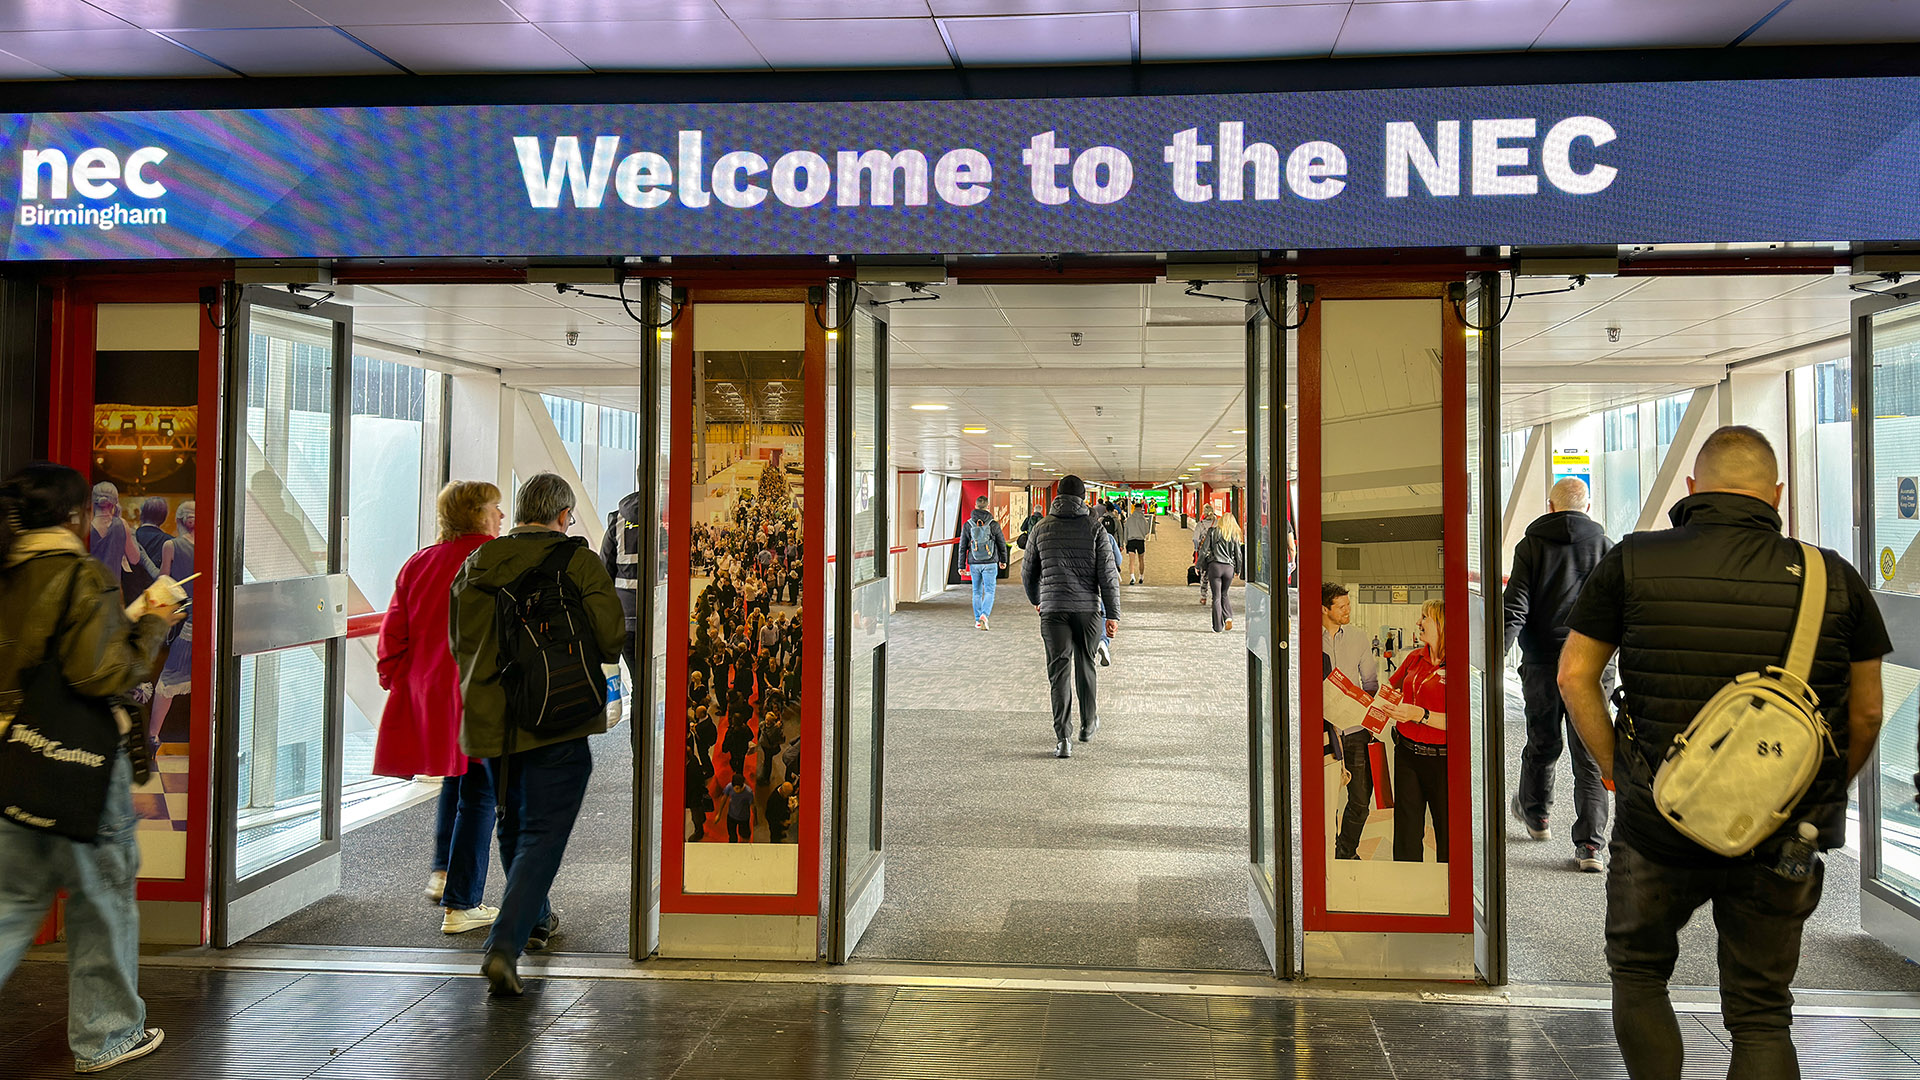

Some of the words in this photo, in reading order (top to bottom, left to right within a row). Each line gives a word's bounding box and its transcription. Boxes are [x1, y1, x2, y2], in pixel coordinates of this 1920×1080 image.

[21, 147, 168, 200] nec
[512, 130, 993, 209] Welcome
[1023, 131, 1134, 205] to
[1165, 121, 1349, 203] the
[1386, 116, 1619, 198] NEC
[20, 203, 167, 230] Birmingham
[1757, 739, 1783, 757] 84
